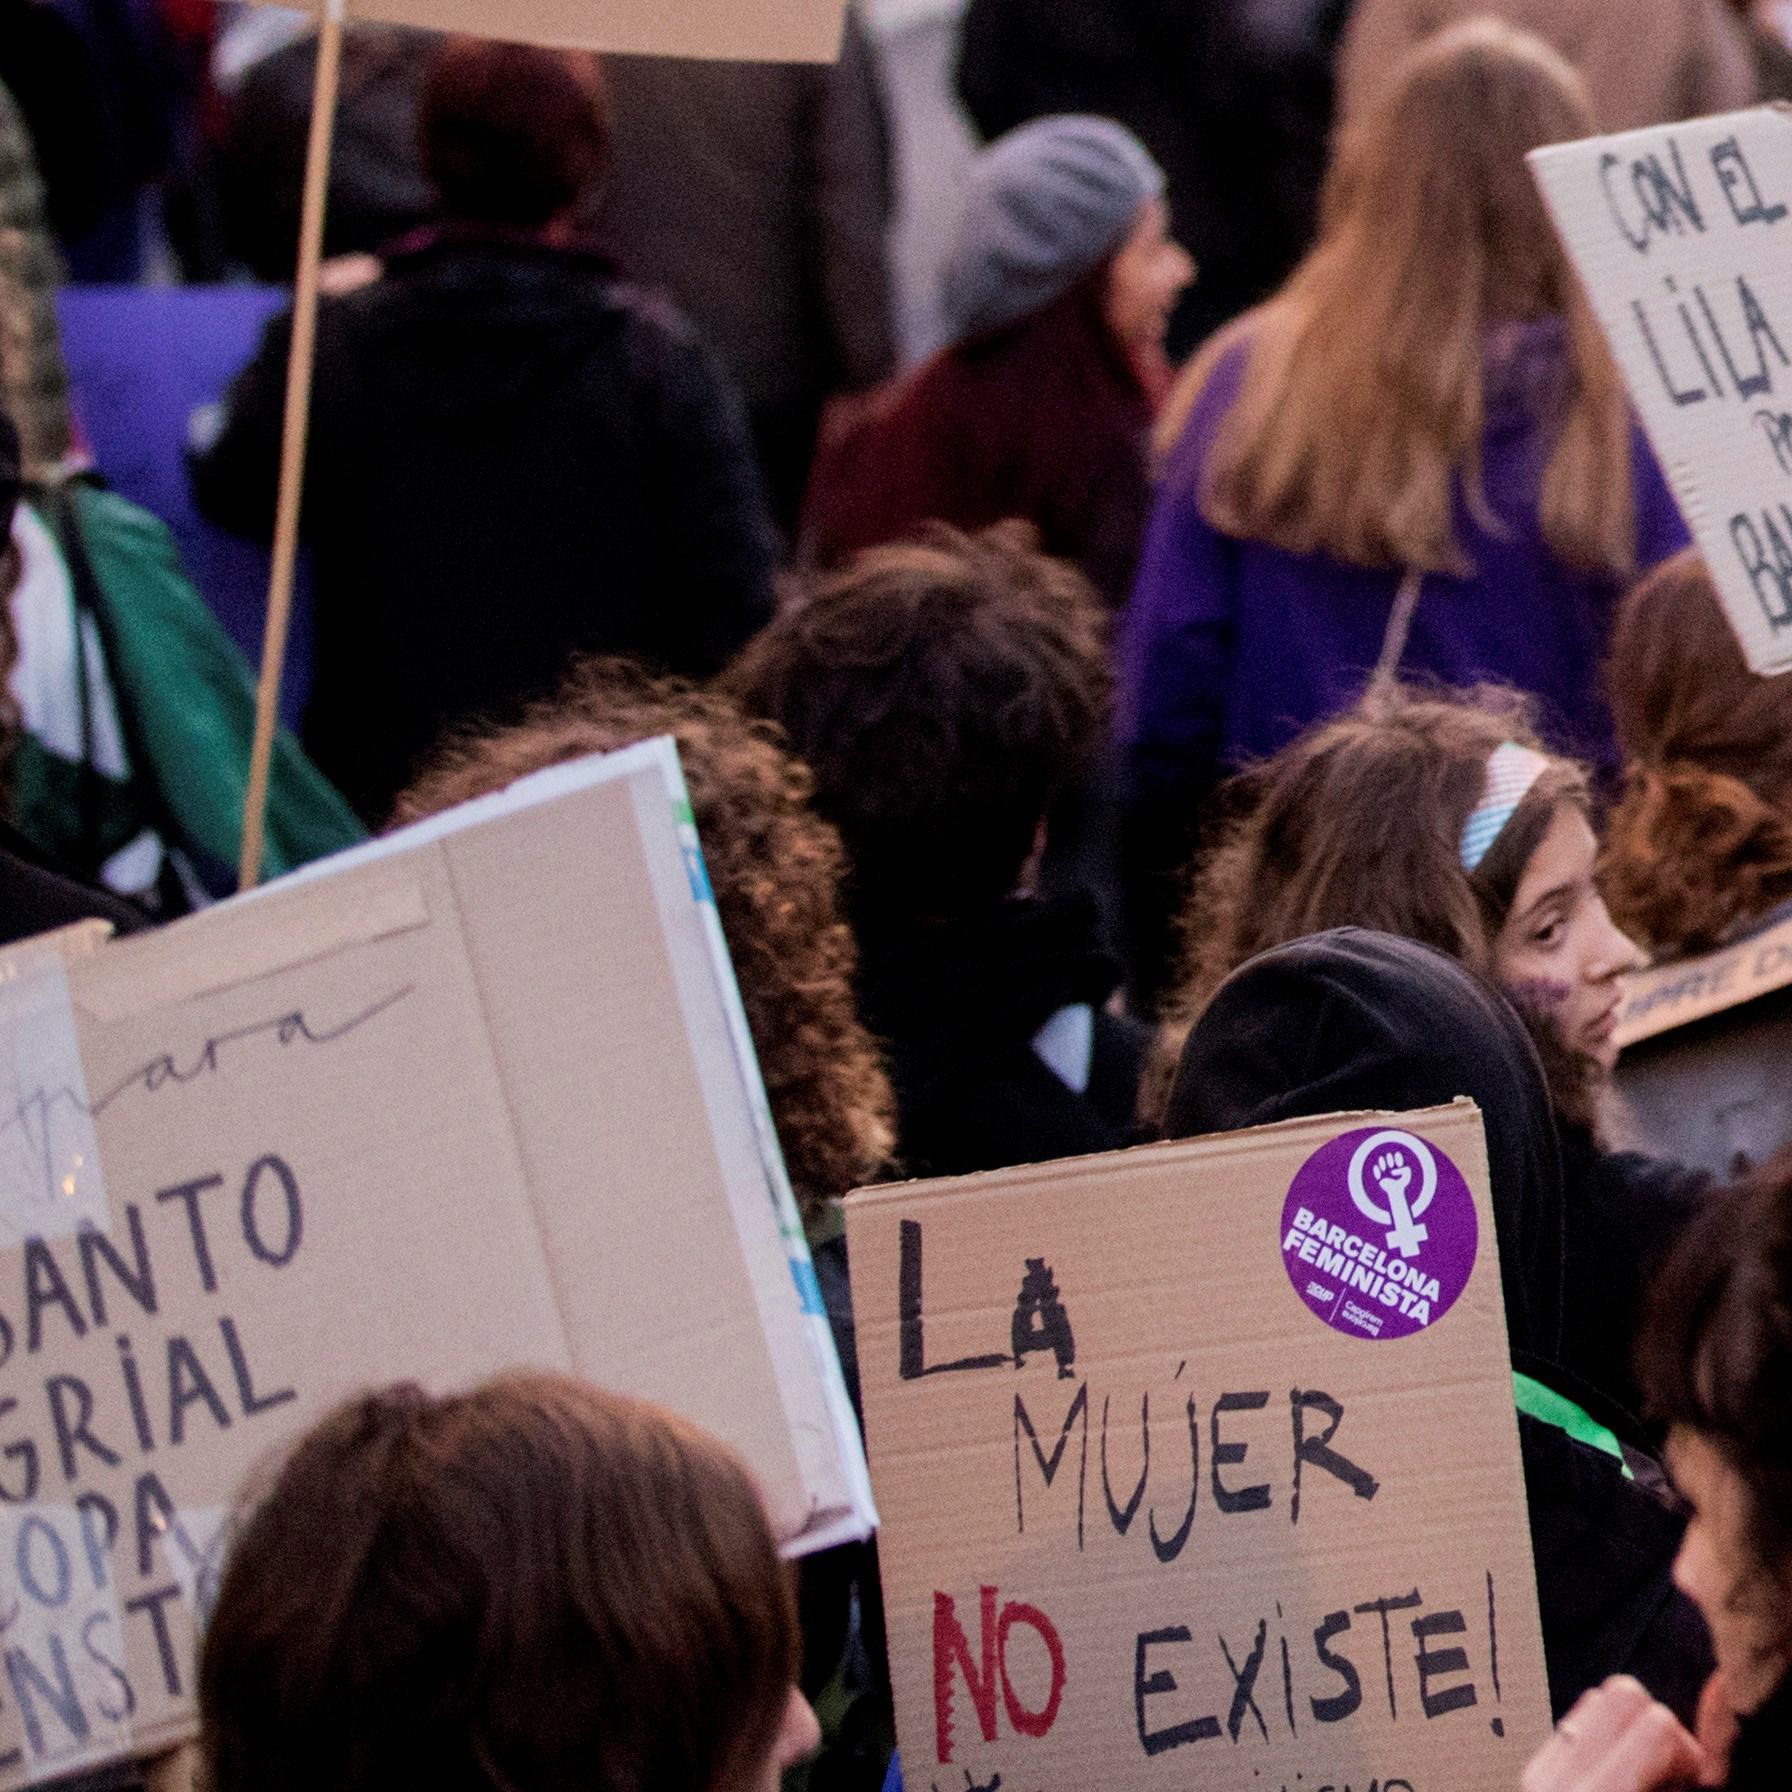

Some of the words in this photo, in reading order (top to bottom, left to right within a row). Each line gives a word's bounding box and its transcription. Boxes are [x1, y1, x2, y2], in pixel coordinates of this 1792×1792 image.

[1599, 137, 1706, 255] CON
[1709, 135, 1790, 225] EL
[899, 1218, 1076, 1381] LA
[1282, 1227, 1431, 1327] FEMINISTA
[1292, 1206, 1441, 1303] BARCELONA
[1013, 1360, 1380, 1564] MUJER
[0, 1470, 203, 1632] OPA
[931, 1584, 1067, 1764] NO
